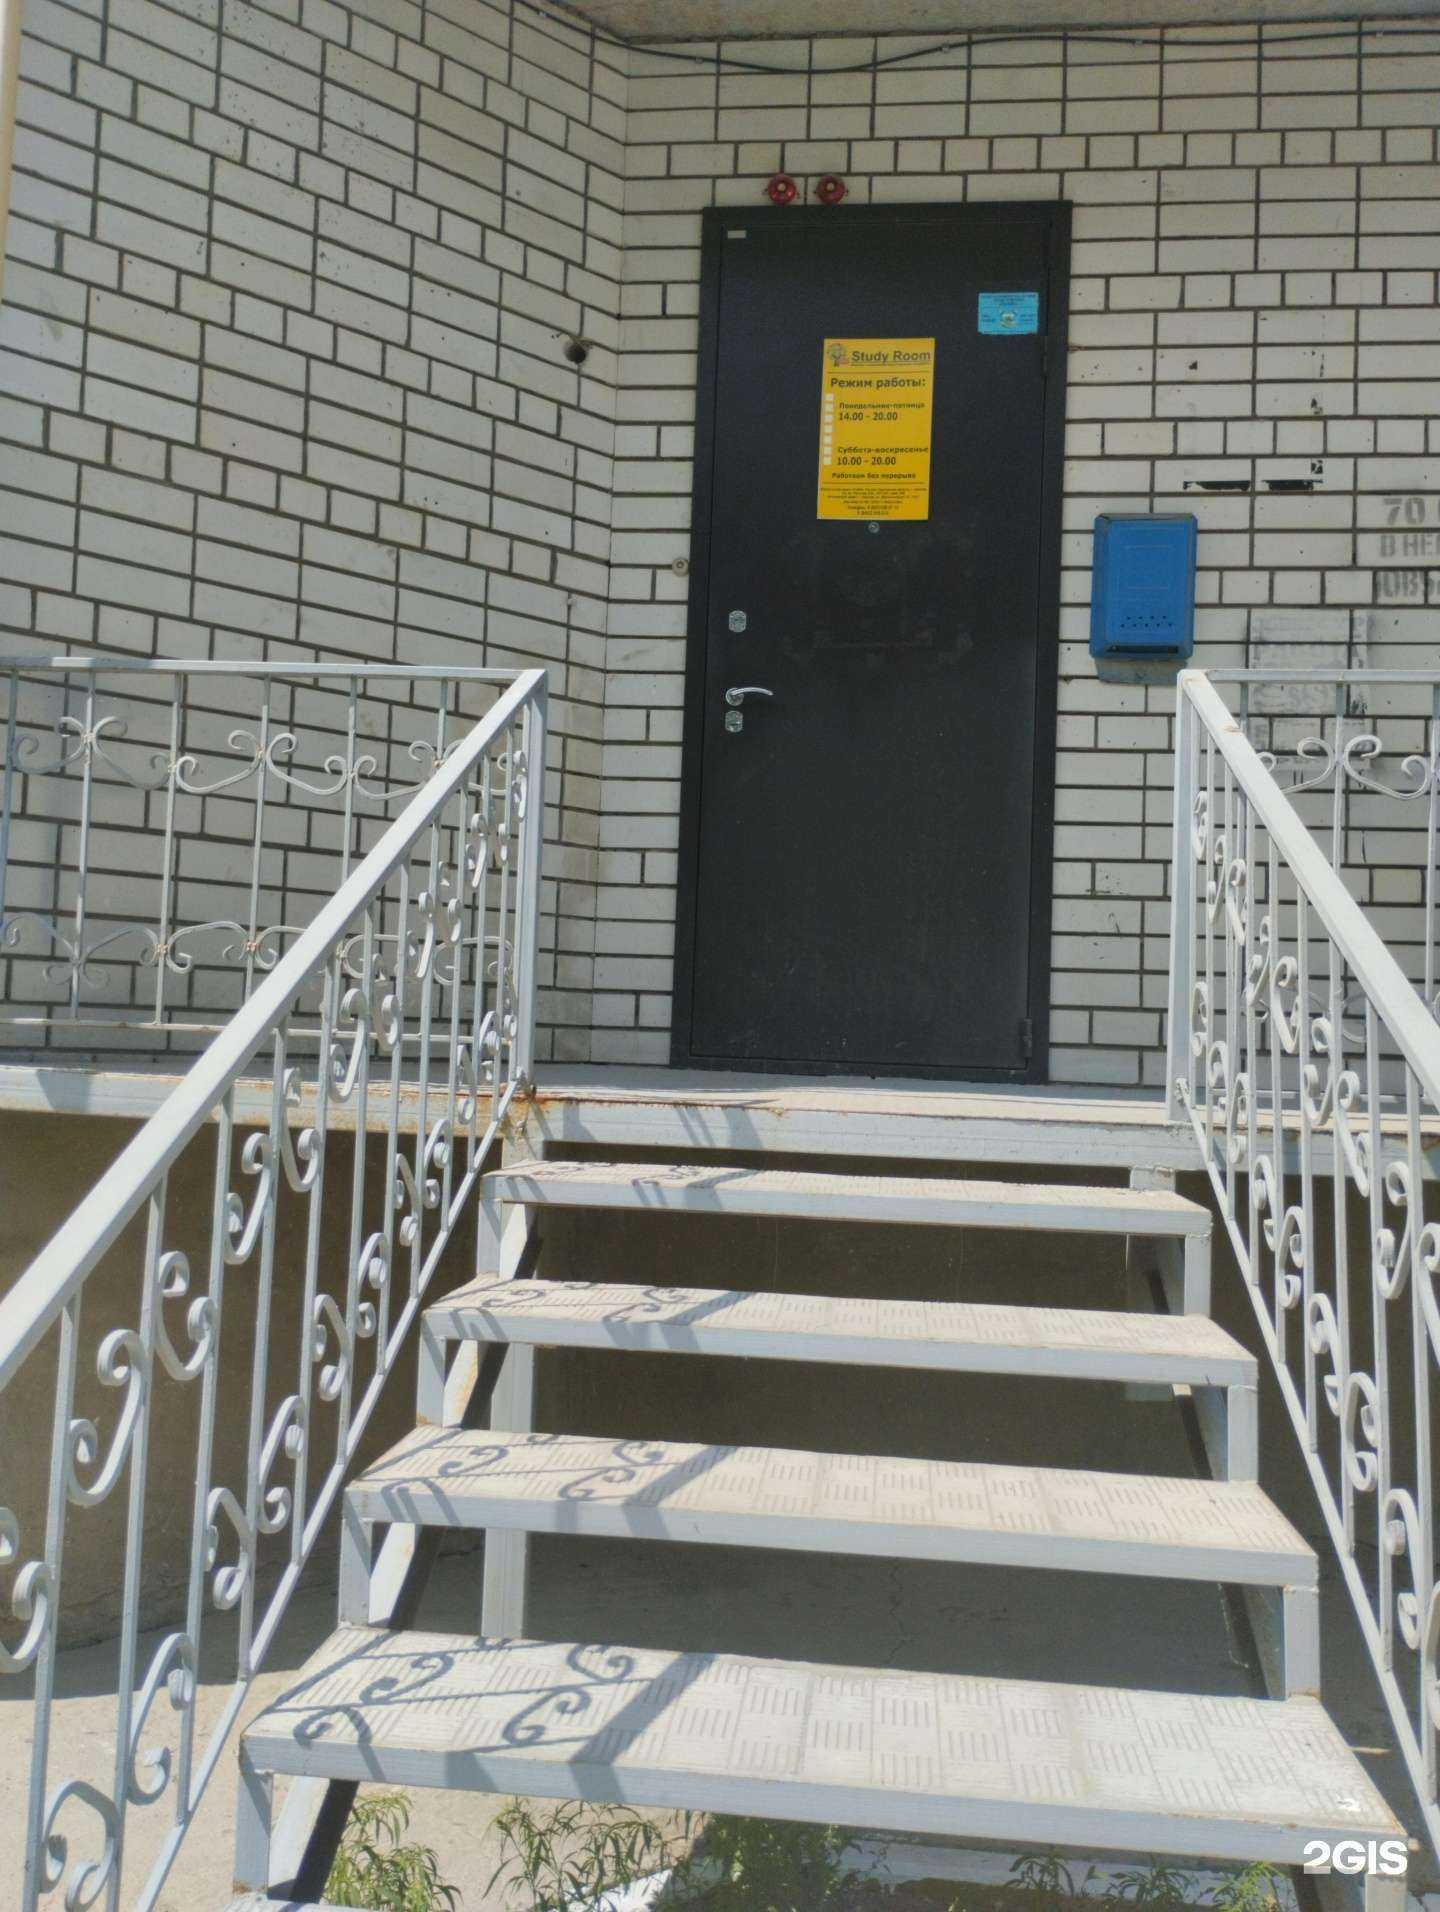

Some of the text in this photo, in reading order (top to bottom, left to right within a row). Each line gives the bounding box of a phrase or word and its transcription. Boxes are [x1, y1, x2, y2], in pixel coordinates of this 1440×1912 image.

[851, 350, 931, 363] Study Room
[831, 377, 926, 390] Режим работы:
[839, 411, 864, 421] 14.00
[873, 411, 898, 421] 20.00
[837, 456, 862, 466] 10.00
[871, 456, 897, 466] 20.00
